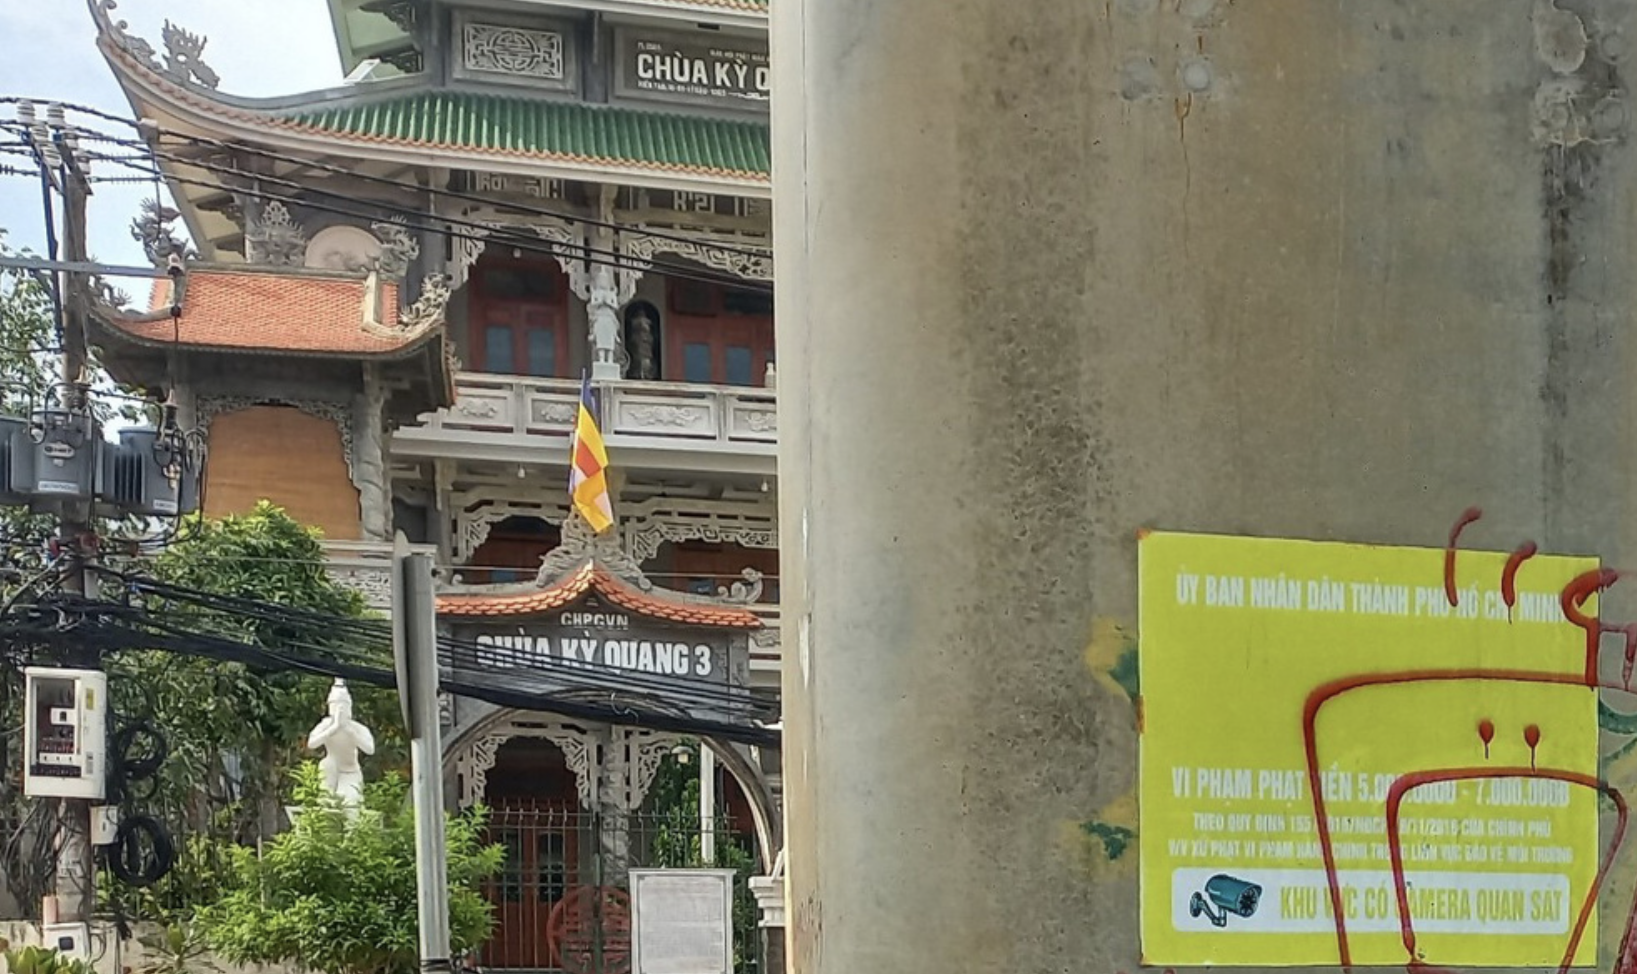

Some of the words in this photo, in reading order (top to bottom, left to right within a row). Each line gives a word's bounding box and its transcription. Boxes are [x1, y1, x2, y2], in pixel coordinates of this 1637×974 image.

[637, 51, 708, 85] CHÙA
[714, 59, 748, 89] KỲ
[1205, 574, 1245, 607] BAN
[1251, 571, 1302, 610] NHÂN
[1307, 574, 1345, 611] DÂN
[561, 631, 598, 669] KỲ
[604, 640, 690, 675] QUANG
[695, 644, 712, 676] 3
[1172, 766, 1191, 798] VI
[1197, 768, 1252, 806] PHẠM
[1258, 770, 1305, 808] PHẠT
[1281, 886, 1317, 920] KHU
[1364, 880, 1388, 920] CÓ
[1476, 888, 1525, 925] QUAN
[1531, 883, 1563, 922] SÁT
